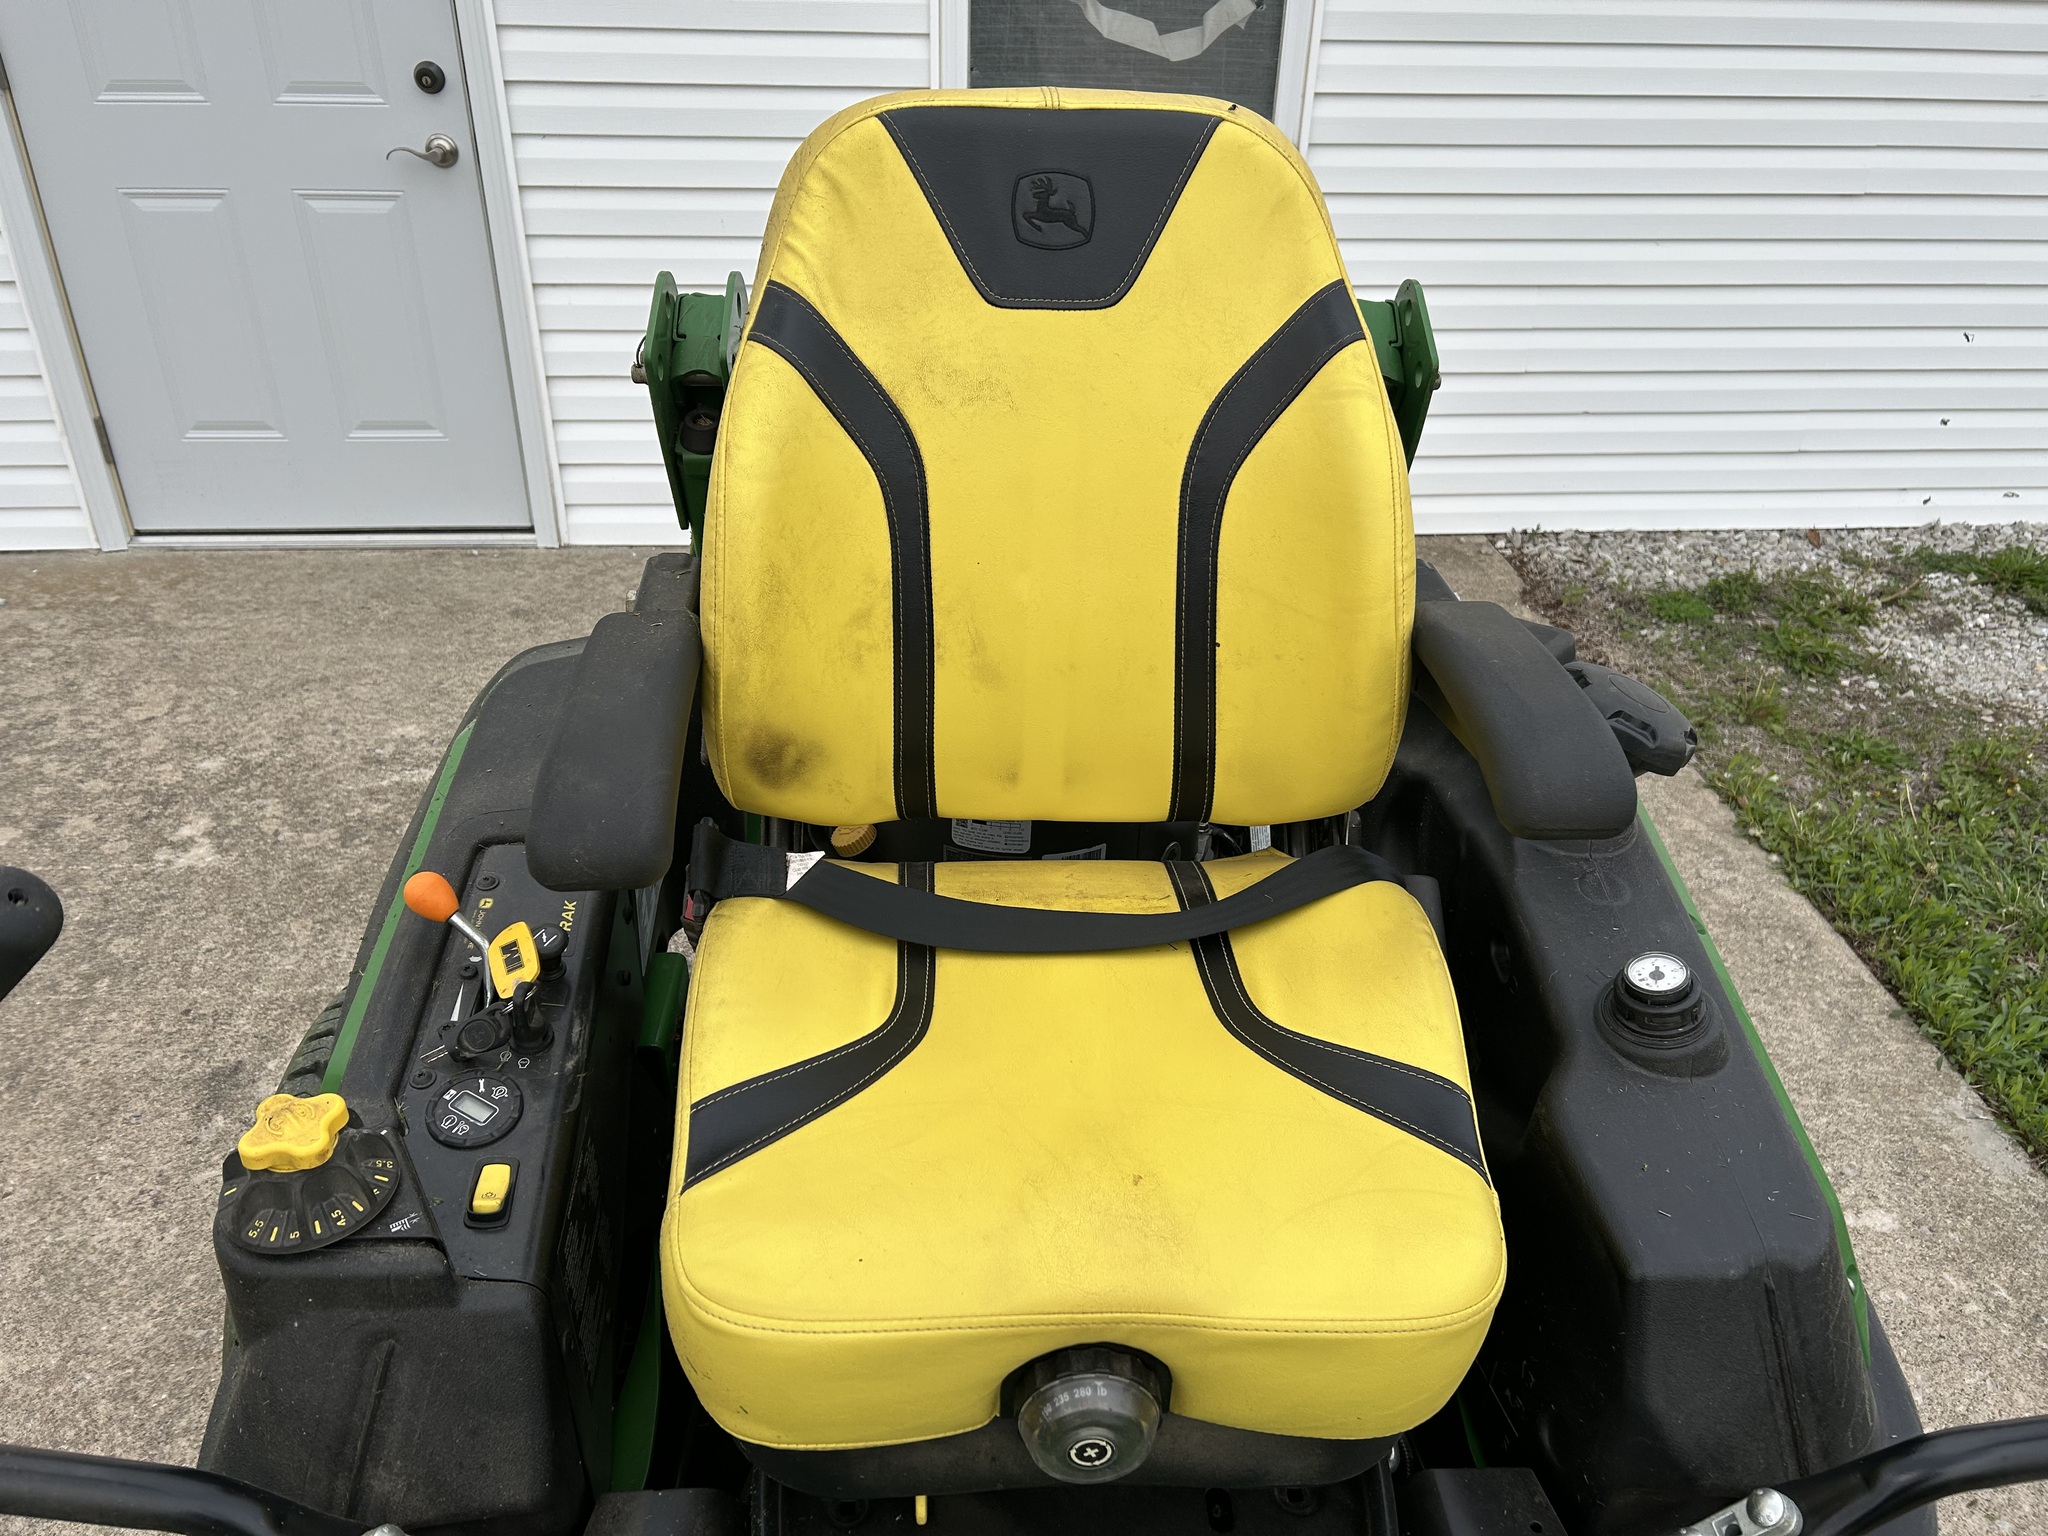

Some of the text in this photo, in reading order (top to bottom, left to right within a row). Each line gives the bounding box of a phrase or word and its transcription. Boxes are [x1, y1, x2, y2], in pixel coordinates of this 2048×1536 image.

[559, 900, 578, 938] RAK
[376, 1160, 393, 1168] 3.5
[331, 1209, 347, 1226] 4.5
[248, 1220, 264, 1238] 5.5
[290, 1231, 300, 1239] 5
[1054, 1392, 1069, 1407] 235
[1073, 1386, 1092, 1398] 280
[1097, 1386, 1107, 1396] lb
